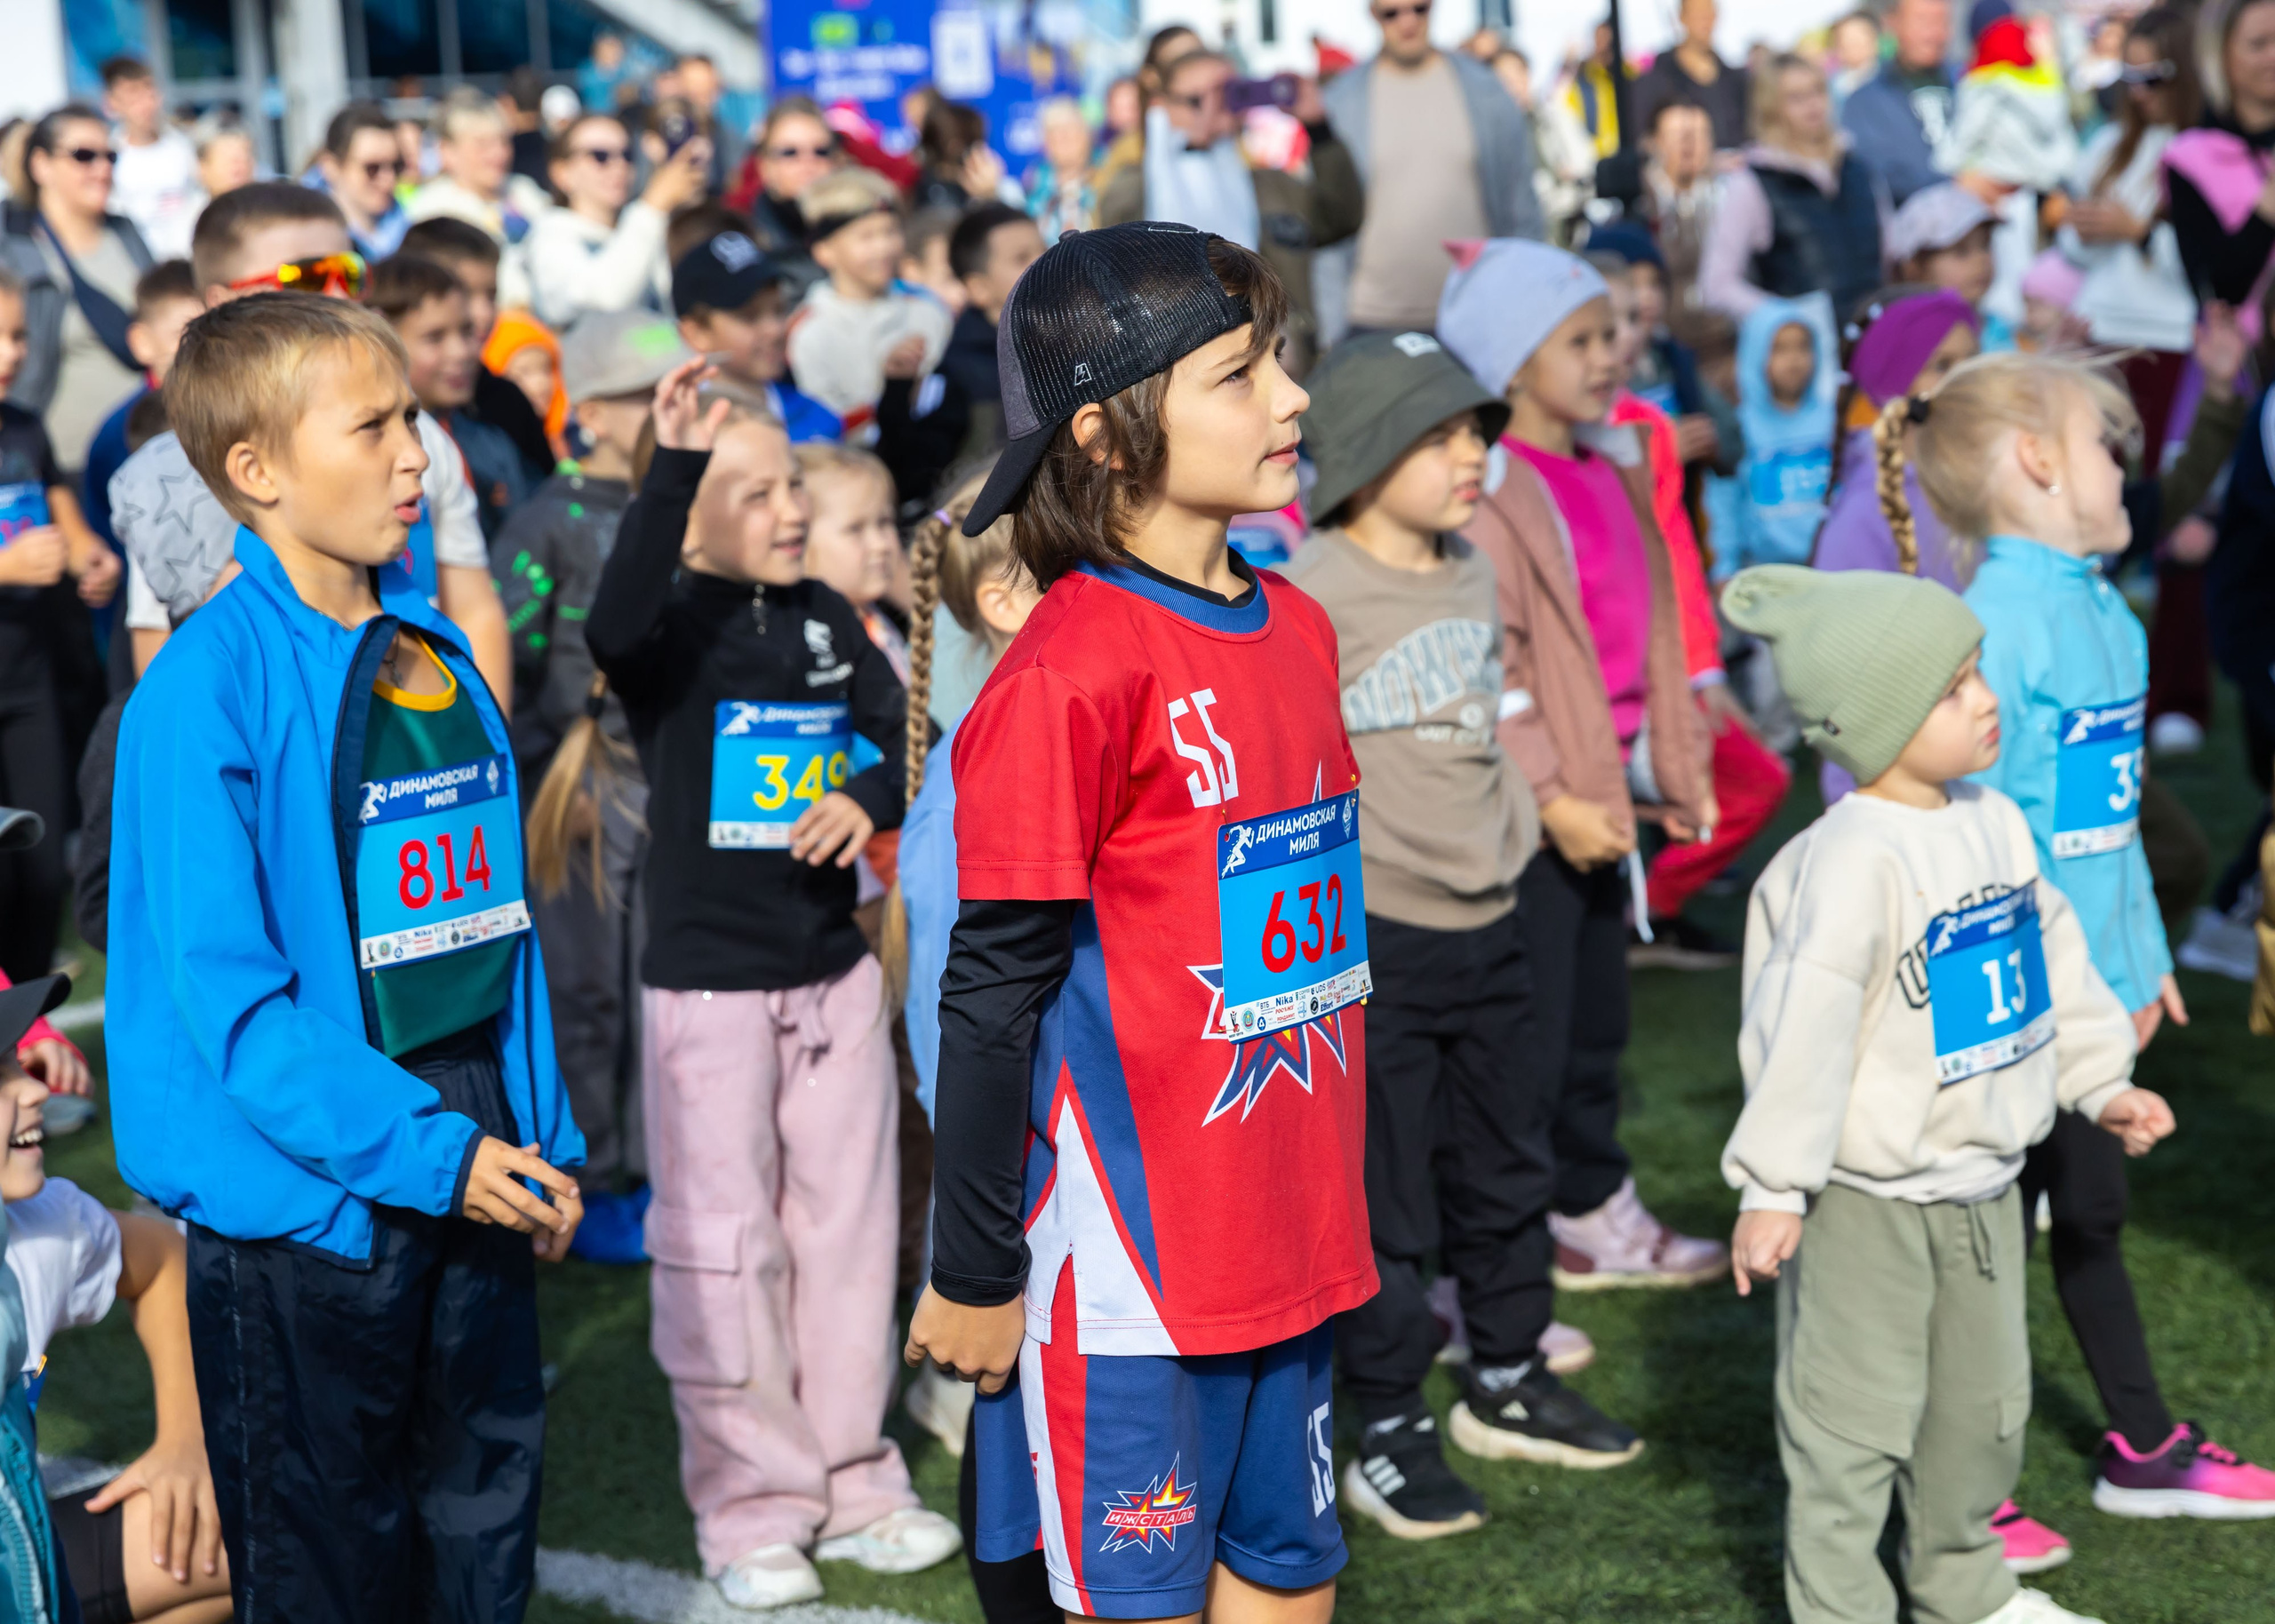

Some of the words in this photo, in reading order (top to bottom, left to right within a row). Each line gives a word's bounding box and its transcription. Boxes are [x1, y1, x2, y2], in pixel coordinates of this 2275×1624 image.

[1167, 688, 1239, 808] 55
[388, 764, 478, 799] ДИНАМОВСКАЯ
[425, 787, 458, 809] МИЛЯ
[1256, 803, 1337, 844] ДИНАМОВСКАЯ
[1289, 831, 1320, 856] МИЛЯ
[398, 824, 491, 910] 814
[1261, 873, 1347, 974] 632
[1275, 996, 1294, 1007] Nika
[1315, 983, 1326, 994] UDS
[1981, 948, 2027, 1025] 13
[1260, 1001, 1270, 1010] ВТБ
[1307, 1401, 1337, 1519] 55
[1109, 1509, 1194, 1526] ИЖСТАЛЬ
